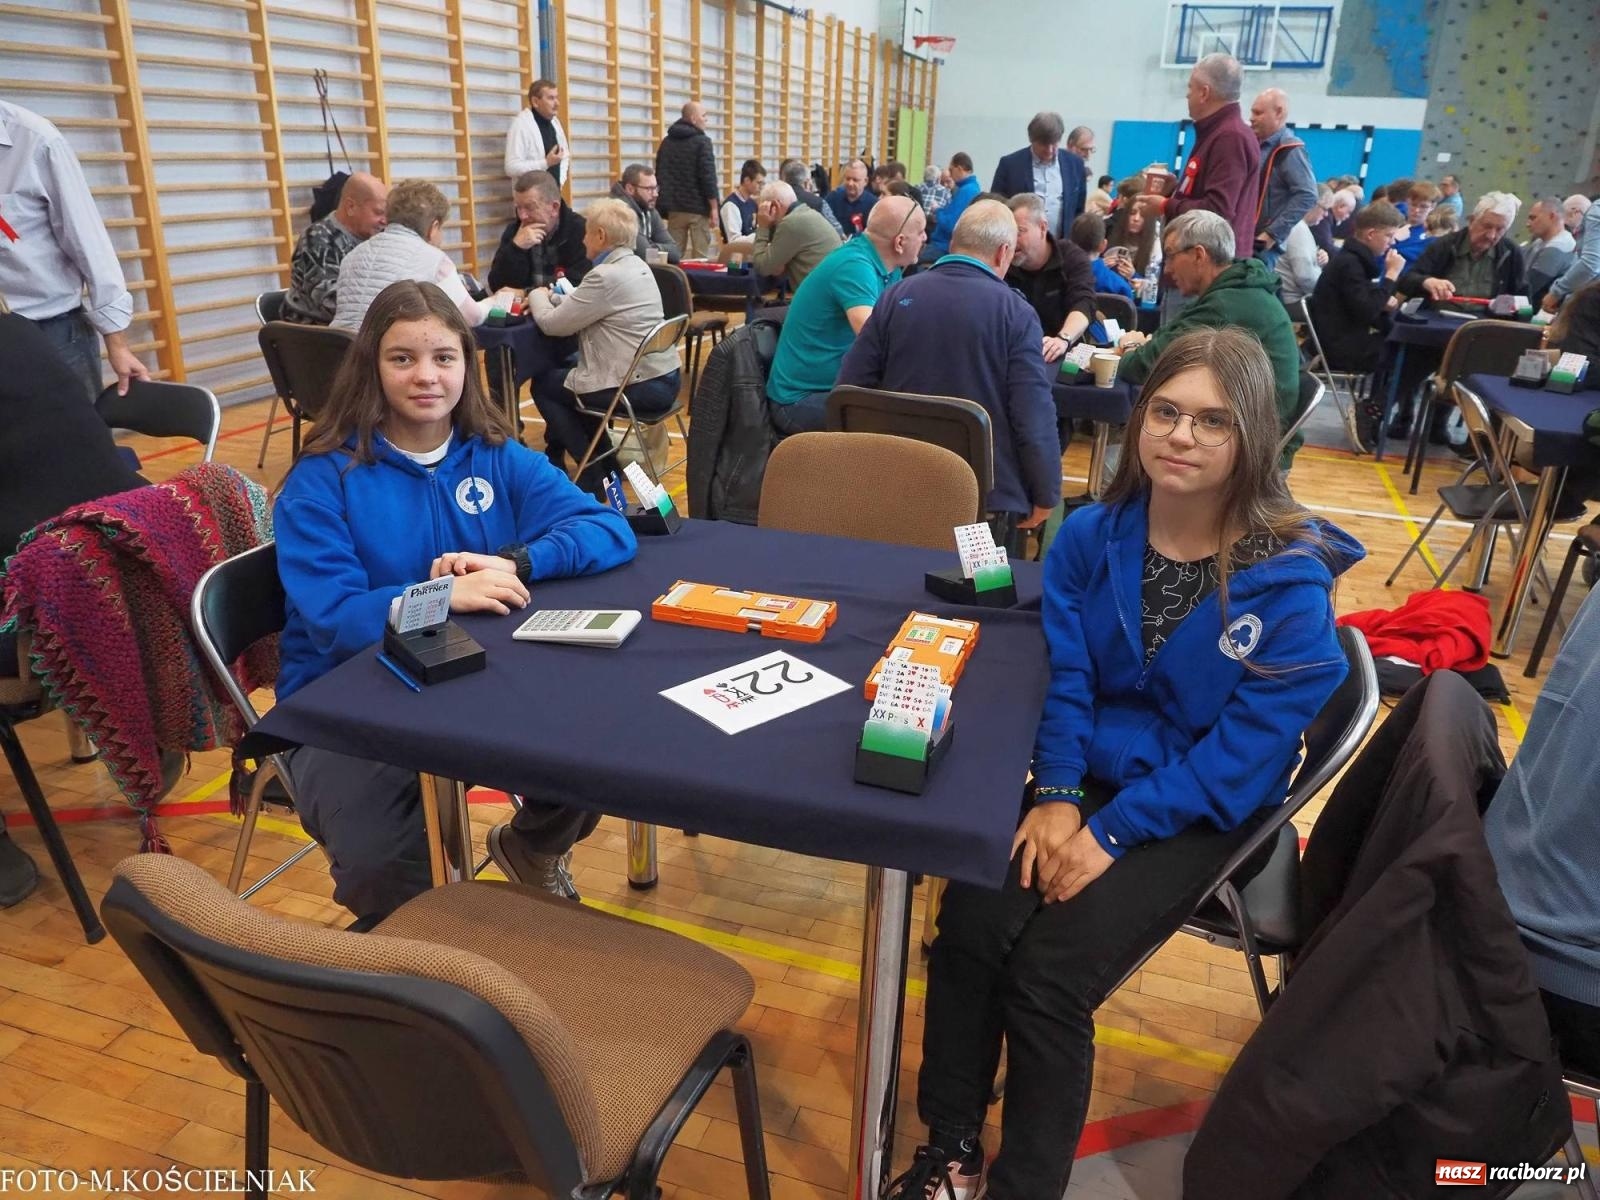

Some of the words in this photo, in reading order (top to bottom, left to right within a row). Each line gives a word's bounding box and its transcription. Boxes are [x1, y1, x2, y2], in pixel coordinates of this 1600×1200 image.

[410, 583, 449, 598] PARTNER
[730, 660, 814, 695] 22
[872, 708, 886, 719] XX
[917, 717, 925, 728] X
